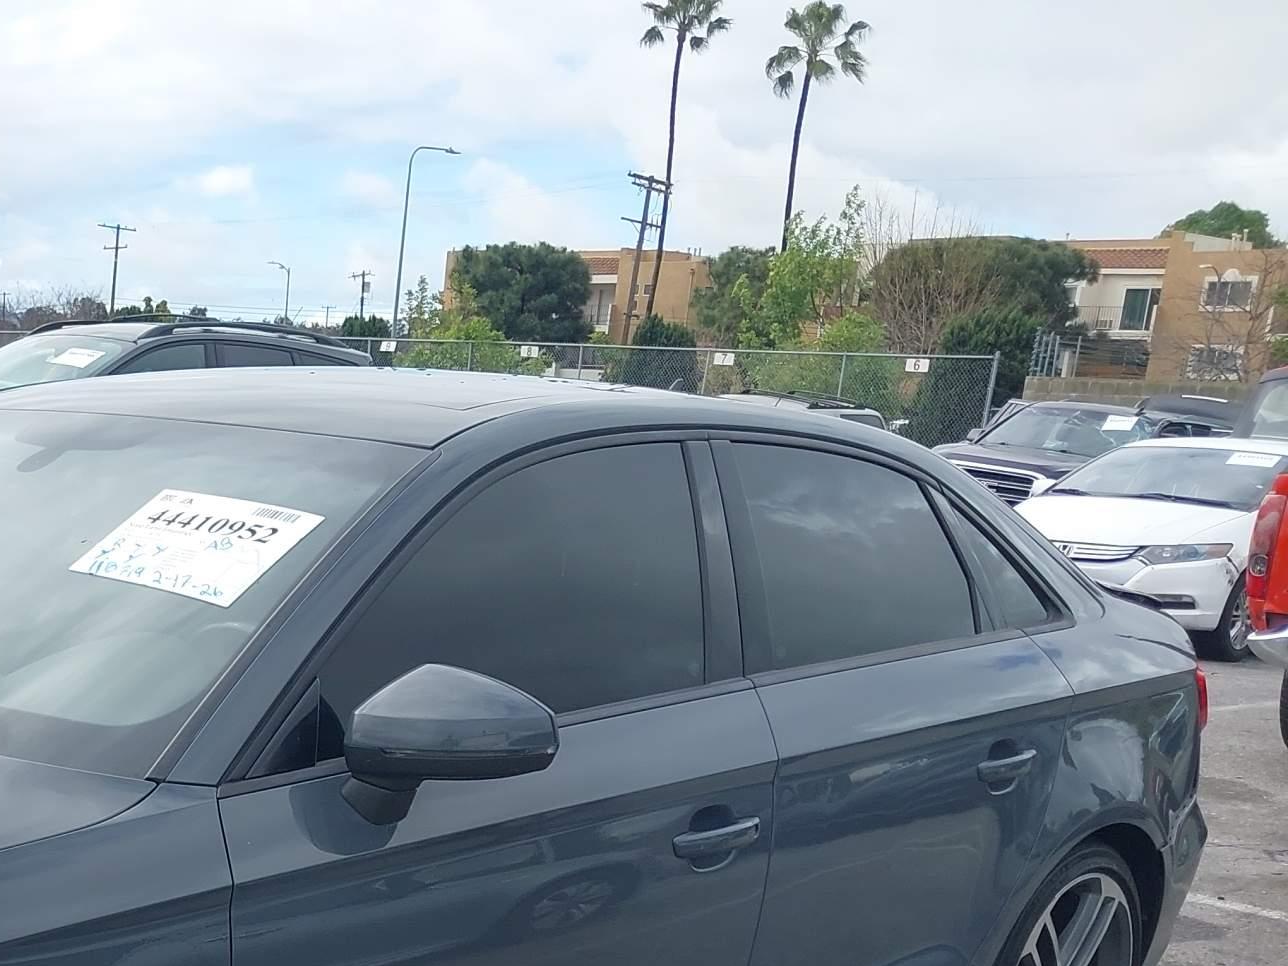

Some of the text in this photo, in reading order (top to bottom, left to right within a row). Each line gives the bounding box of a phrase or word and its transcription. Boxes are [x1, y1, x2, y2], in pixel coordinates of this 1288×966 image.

[721, 353, 728, 364] 7
[913, 359, 921, 371] 6
[147, 509, 279, 544] 44410952
